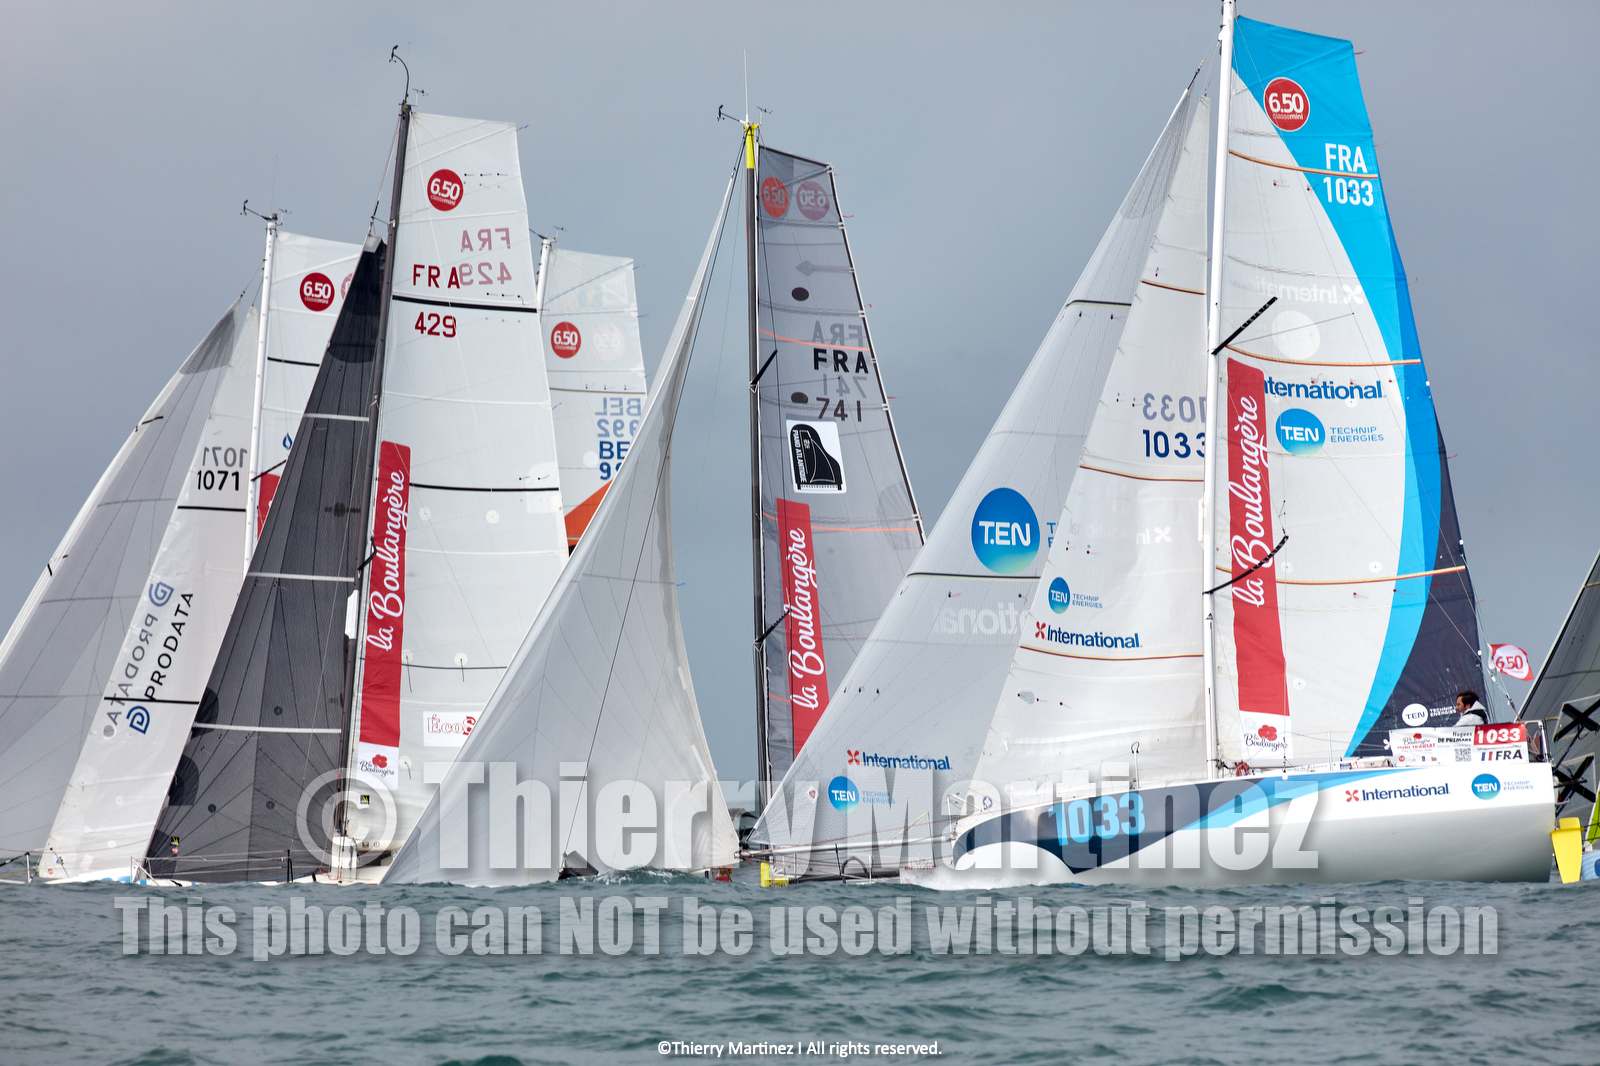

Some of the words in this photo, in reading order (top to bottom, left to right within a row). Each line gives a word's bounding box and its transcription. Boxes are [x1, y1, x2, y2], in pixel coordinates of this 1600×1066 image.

[1268, 92, 1304, 113] 6.50
[1324, 142, 1368, 173] FRA
[430, 178, 461, 200] 6.50
[1322, 176, 1374, 206] 1033
[412, 264, 460, 289] FRA
[303, 280, 332, 299] 6.50
[414, 311, 457, 338] 429
[553, 330, 579, 346] 6.50
[813, 348, 869, 374] FRA
[1264, 376, 1383, 399] ternational
[816, 397, 862, 422] 741
[1280, 425, 1320, 442] T.EN
[1330, 426, 1377, 434] TECHNIP
[1330, 434, 1384, 442] ENERGIES
[599, 440, 631, 460] BE
[197, 470, 240, 491] 1071
[1228, 396, 1274, 570] Boulangère
[978, 520, 1031, 546] T.EN
[370, 470, 409, 620] Boulangère
[784, 527, 825, 679] Boulangère
[1050, 589, 1068, 604] T.EN
[1072, 593, 1099, 601] TECHNIP
[1231, 577, 1264, 608] la
[1072, 600, 1103, 609] ENERGIES
[144, 593, 194, 700] PRODATA
[366, 626, 394, 651] la
[1047, 624, 1140, 649] International
[790, 684, 818, 710] la
[1477, 728, 1520, 743] 1033
[862, 752, 950, 770] International
[1496, 750, 1522, 760] FRA
[831, 789, 856, 802] T.EN
[1362, 783, 1449, 801] International
[1048, 792, 1145, 846] 1033
